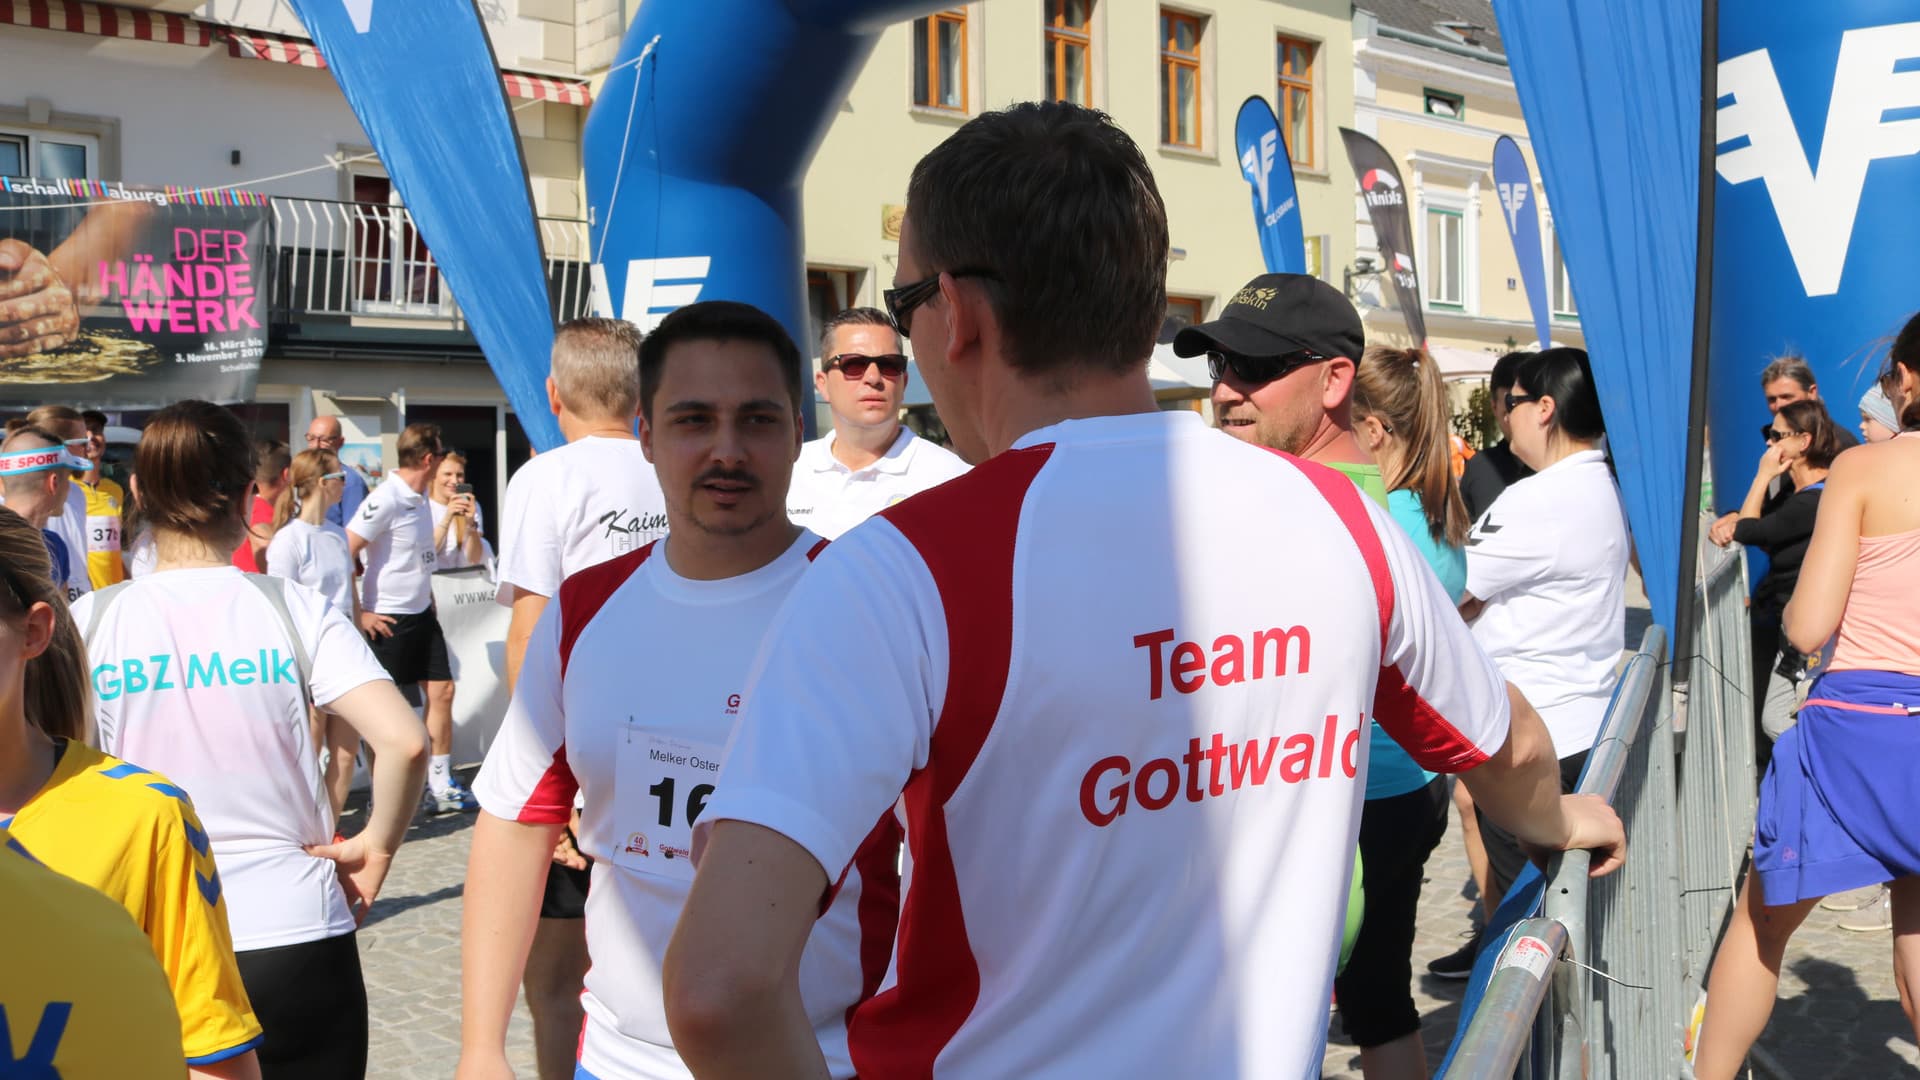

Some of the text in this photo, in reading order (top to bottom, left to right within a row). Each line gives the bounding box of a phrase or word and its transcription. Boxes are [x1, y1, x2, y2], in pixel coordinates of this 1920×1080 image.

[174, 227, 249, 263] DER
[99, 253, 254, 298] HÄNDE
[123, 297, 262, 333] WERK
[186, 350, 238, 363] November
[18, 453, 58, 468] SPORT
[92, 649, 297, 701] GBZ Melk
[1133, 625, 1311, 701] Team
[649, 749, 720, 772] Melker Oster
